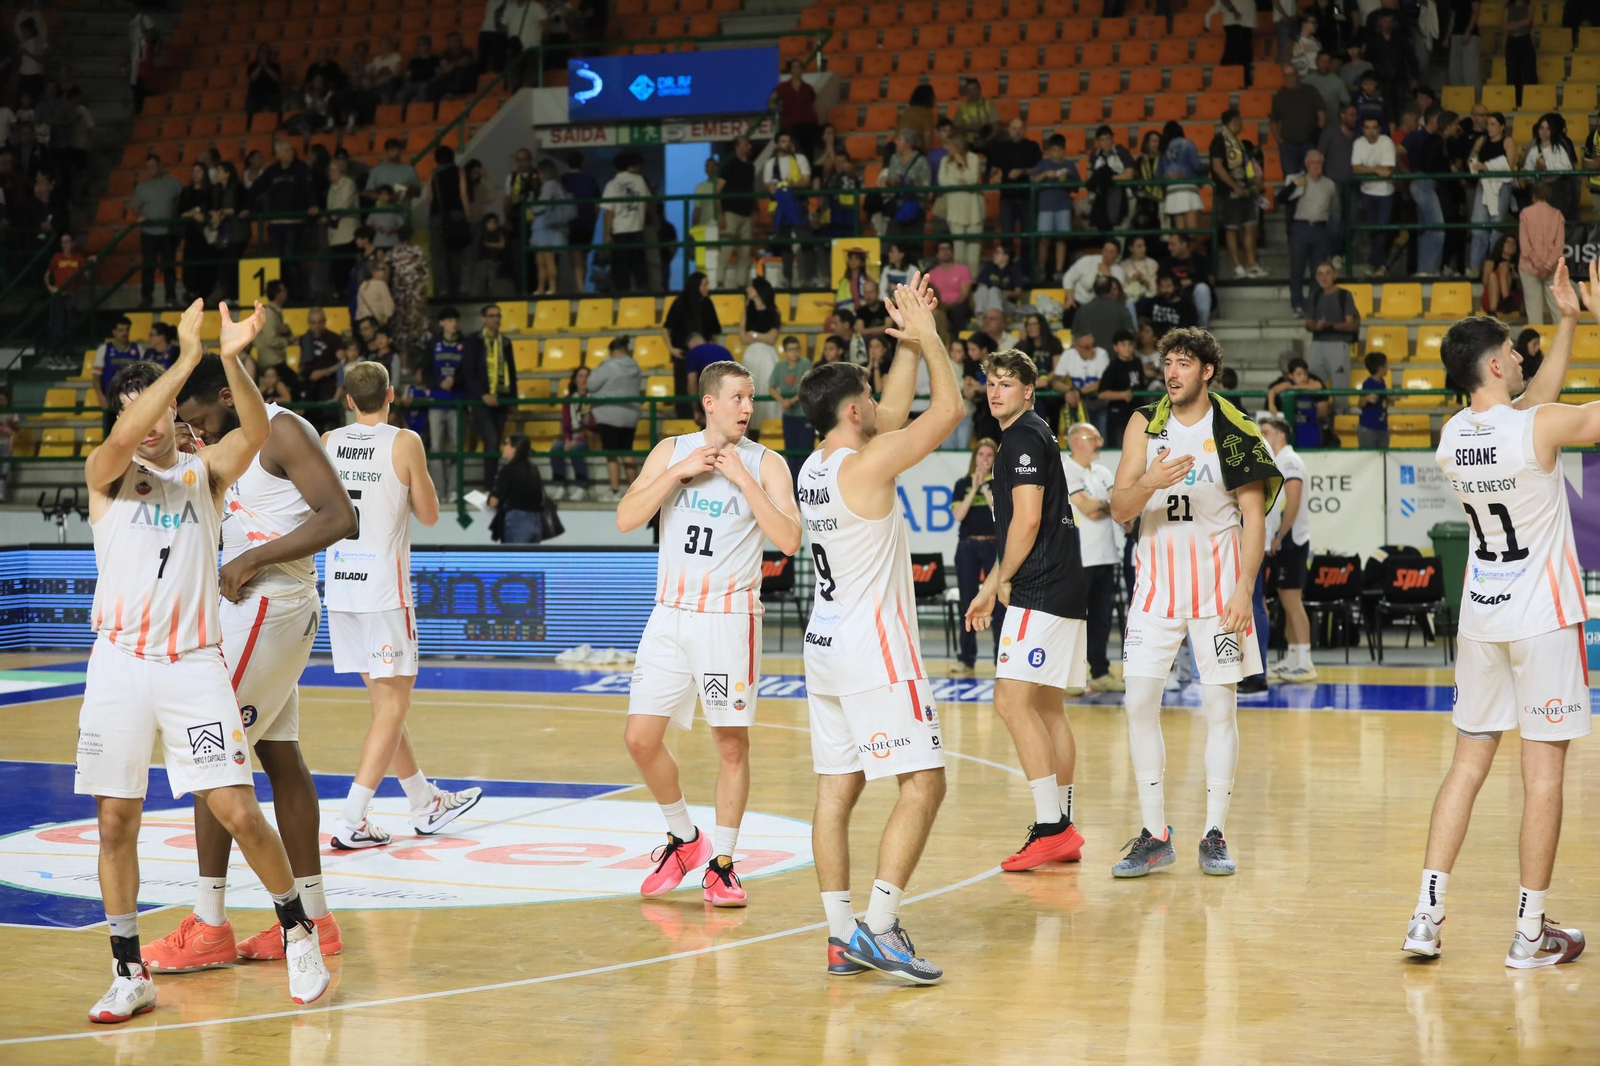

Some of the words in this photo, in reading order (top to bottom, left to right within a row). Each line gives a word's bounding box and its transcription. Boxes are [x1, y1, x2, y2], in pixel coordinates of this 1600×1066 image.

[1563, 243, 1600, 263] PIS
[253, 267, 265, 297] 1
[337, 446, 375, 460] MURPHY
[1455, 447, 1497, 466] SEOANE
[352, 471, 382, 482] ENERGY
[1311, 475, 1352, 491] RTE
[1477, 478, 1517, 493] ENERGY
[674, 488, 741, 518] AlegA
[1167, 495, 1193, 521] 21
[1308, 497, 1341, 513] GO
[1463, 502, 1529, 562] 11
[684, 525, 713, 557] 31
[334, 572, 368, 581] BILADU
[1524, 703, 1582, 715] CANDECRIS
